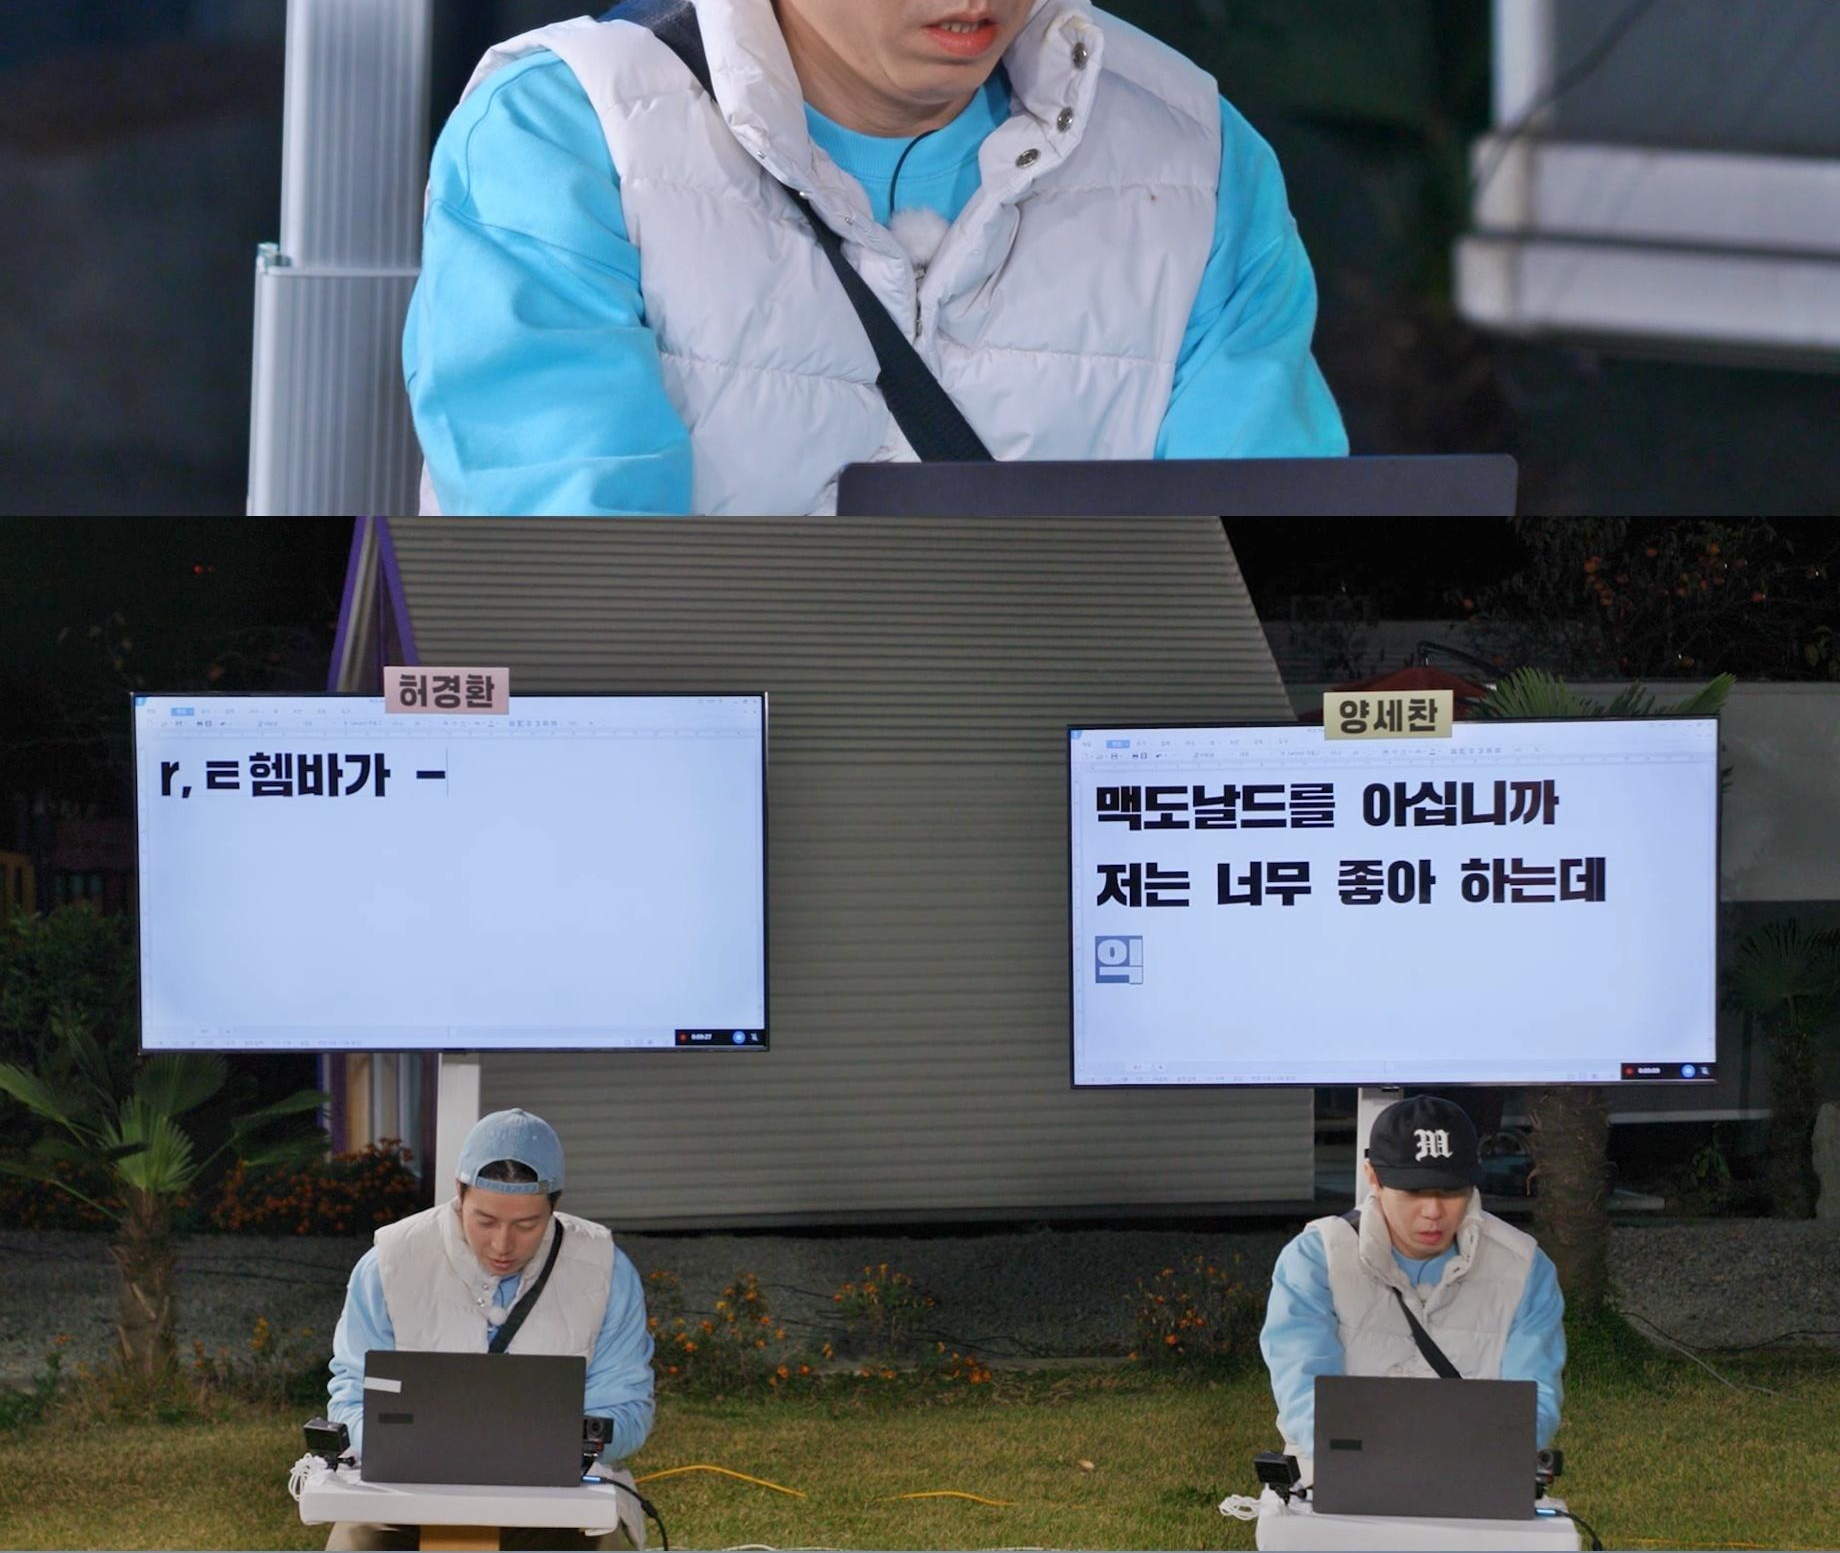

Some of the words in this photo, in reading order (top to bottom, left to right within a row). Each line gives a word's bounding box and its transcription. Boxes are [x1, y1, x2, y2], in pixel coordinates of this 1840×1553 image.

[400, 674, 495, 709] 허경환
[1339, 698, 1438, 734] 양세찬
[1096, 783, 1335, 831] 맥도날드를
[1363, 779, 1560, 827] 아십니까
[1096, 862, 1190, 907] 저는
[1217, 861, 1312, 906] 너무
[1338, 859, 1436, 905] 좋아
[1460, 857, 1606, 904] 하는데
[1413, 1129, 1454, 1162] M
